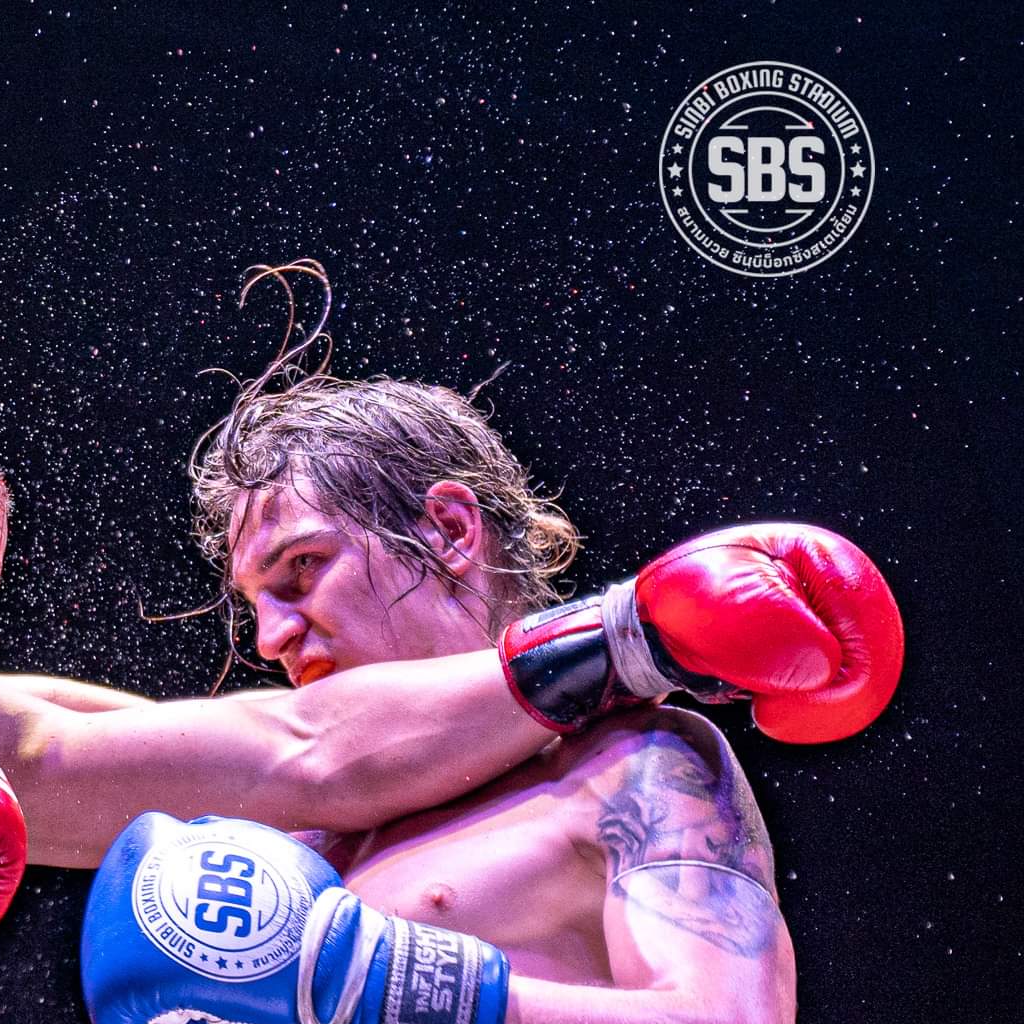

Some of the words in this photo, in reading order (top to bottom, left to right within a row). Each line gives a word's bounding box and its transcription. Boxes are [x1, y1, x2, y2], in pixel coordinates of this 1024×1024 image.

[141, 874, 163, 924] BOXING
[194, 850, 256, 938] SBS
[155, 921, 196, 959] SINBI
